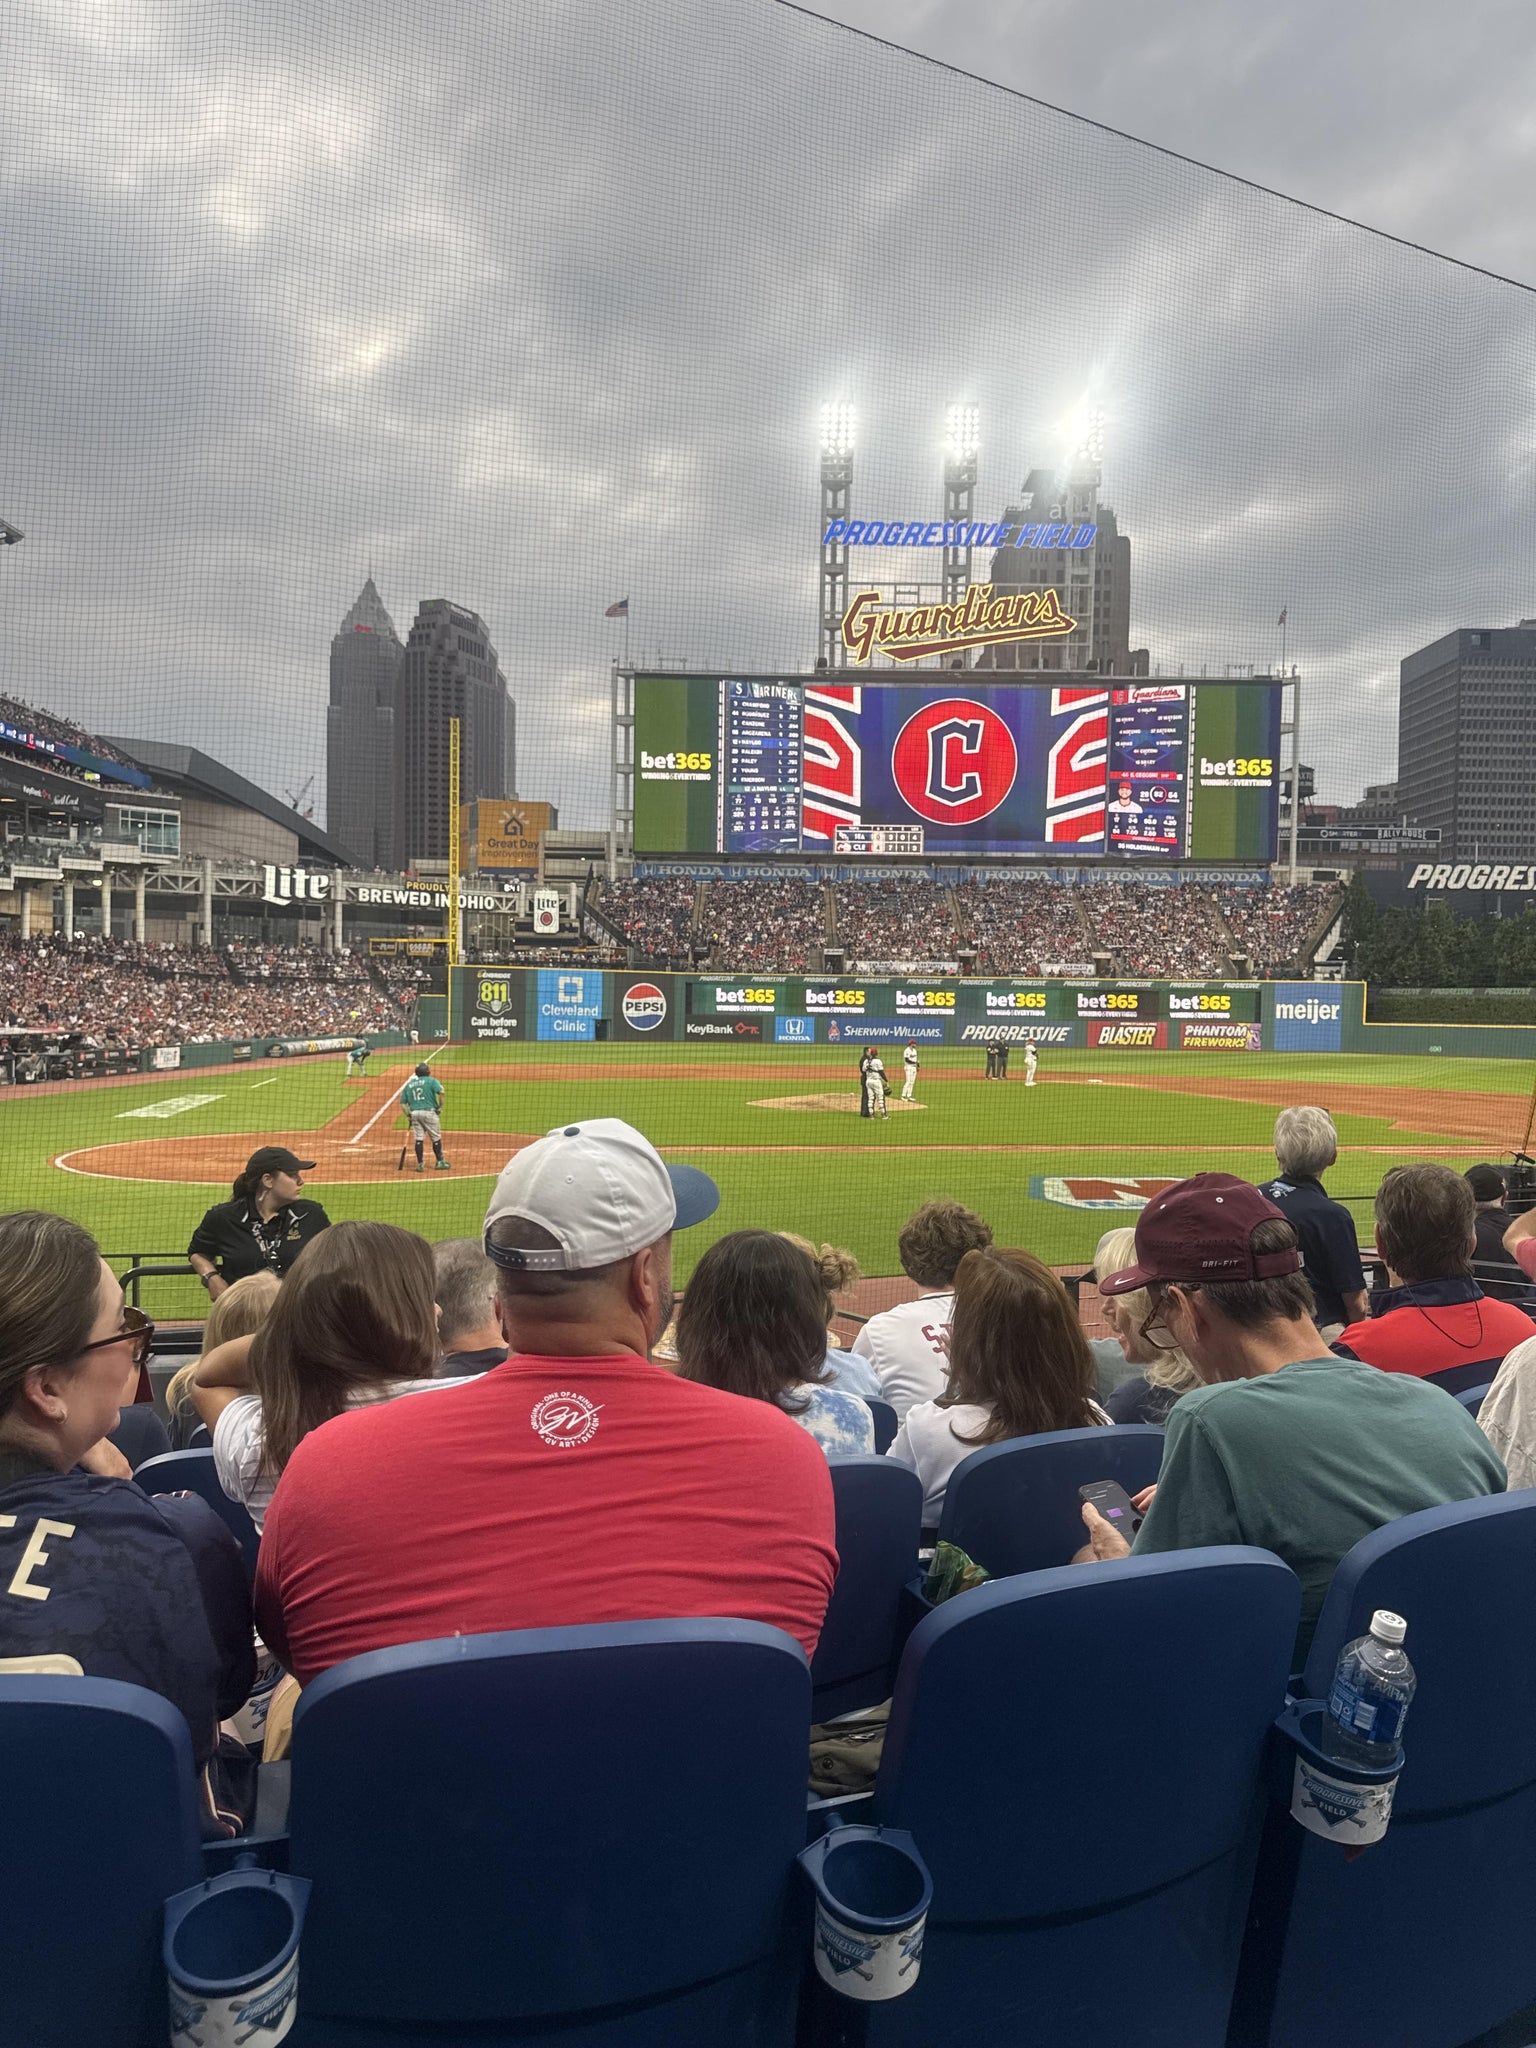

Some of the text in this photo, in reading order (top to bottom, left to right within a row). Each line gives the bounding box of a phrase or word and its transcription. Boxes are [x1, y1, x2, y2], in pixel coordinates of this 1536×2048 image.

[822, 520, 1097, 549] PROGRESSIVE FIELD
[842, 584, 1077, 665] Guardians
[641, 751, 711, 770] bet365
[925, 719, 985, 807] C
[1200, 758, 1272, 776] bet365
[1378, 829, 1426, 839] RALLY HOUSE
[488, 838, 539, 849] Great Day
[481, 849, 538, 858] Improvemen
[658, 866, 724, 876] HONDA
[746, 867, 812, 878] HONDA
[864, 869, 930, 879] HONDA
[985, 870, 1051, 881] HONDA
[1104, 871, 1172, 882] HONDA
[1194, 872, 1263, 883] HONDA
[262, 864, 329, 905] Lite
[406, 881, 451, 892] PROUDLY
[359, 888, 494, 910] BREWED IN OHIO
[537, 898, 557, 911] Lite
[481, 982, 507, 1002] 811
[716, 988, 775, 1004] bet365
[806, 989, 865, 1005] bet365
[896, 991, 955, 1006] bet365
[625, 1002, 664, 1012] PEPSI
[986, 992, 1046, 1008] bet365
[1077, 993, 1138, 1009] bet365
[1170, 994, 1231, 1010] bet365
[542, 1004, 599, 1017] Cleveland
[1276, 999, 1340, 1024] meijer
[471, 1017, 517, 1026] Call before
[554, 1020, 586, 1032] Clinic
[478, 1027, 510, 1038] you dig.
[687, 1024, 733, 1035] KeyBank
[961, 1025, 1069, 1041] PROGRESSIVE
[1098, 1026, 1156, 1045] BLASTER
[1185, 1025, 1247, 1037] PHANTOM
[1183, 1037, 1247, 1048] FIREWORKS
[412, 1088, 425, 1100] 12
[1202, 1260, 1239, 1268] DRI-FIT
[531, 1402, 544, 1430] ORIGINAL
[544, 1392, 559, 1402] ONE
[577, 1394, 593, 1409] KIND
[582, 1417, 599, 1443] DESIGN
[1305, 1780, 1365, 1808] PROGRESSIVE
[1319, 1801, 1347, 1817] FIELD
[826, 1946, 851, 1966] FIELD
